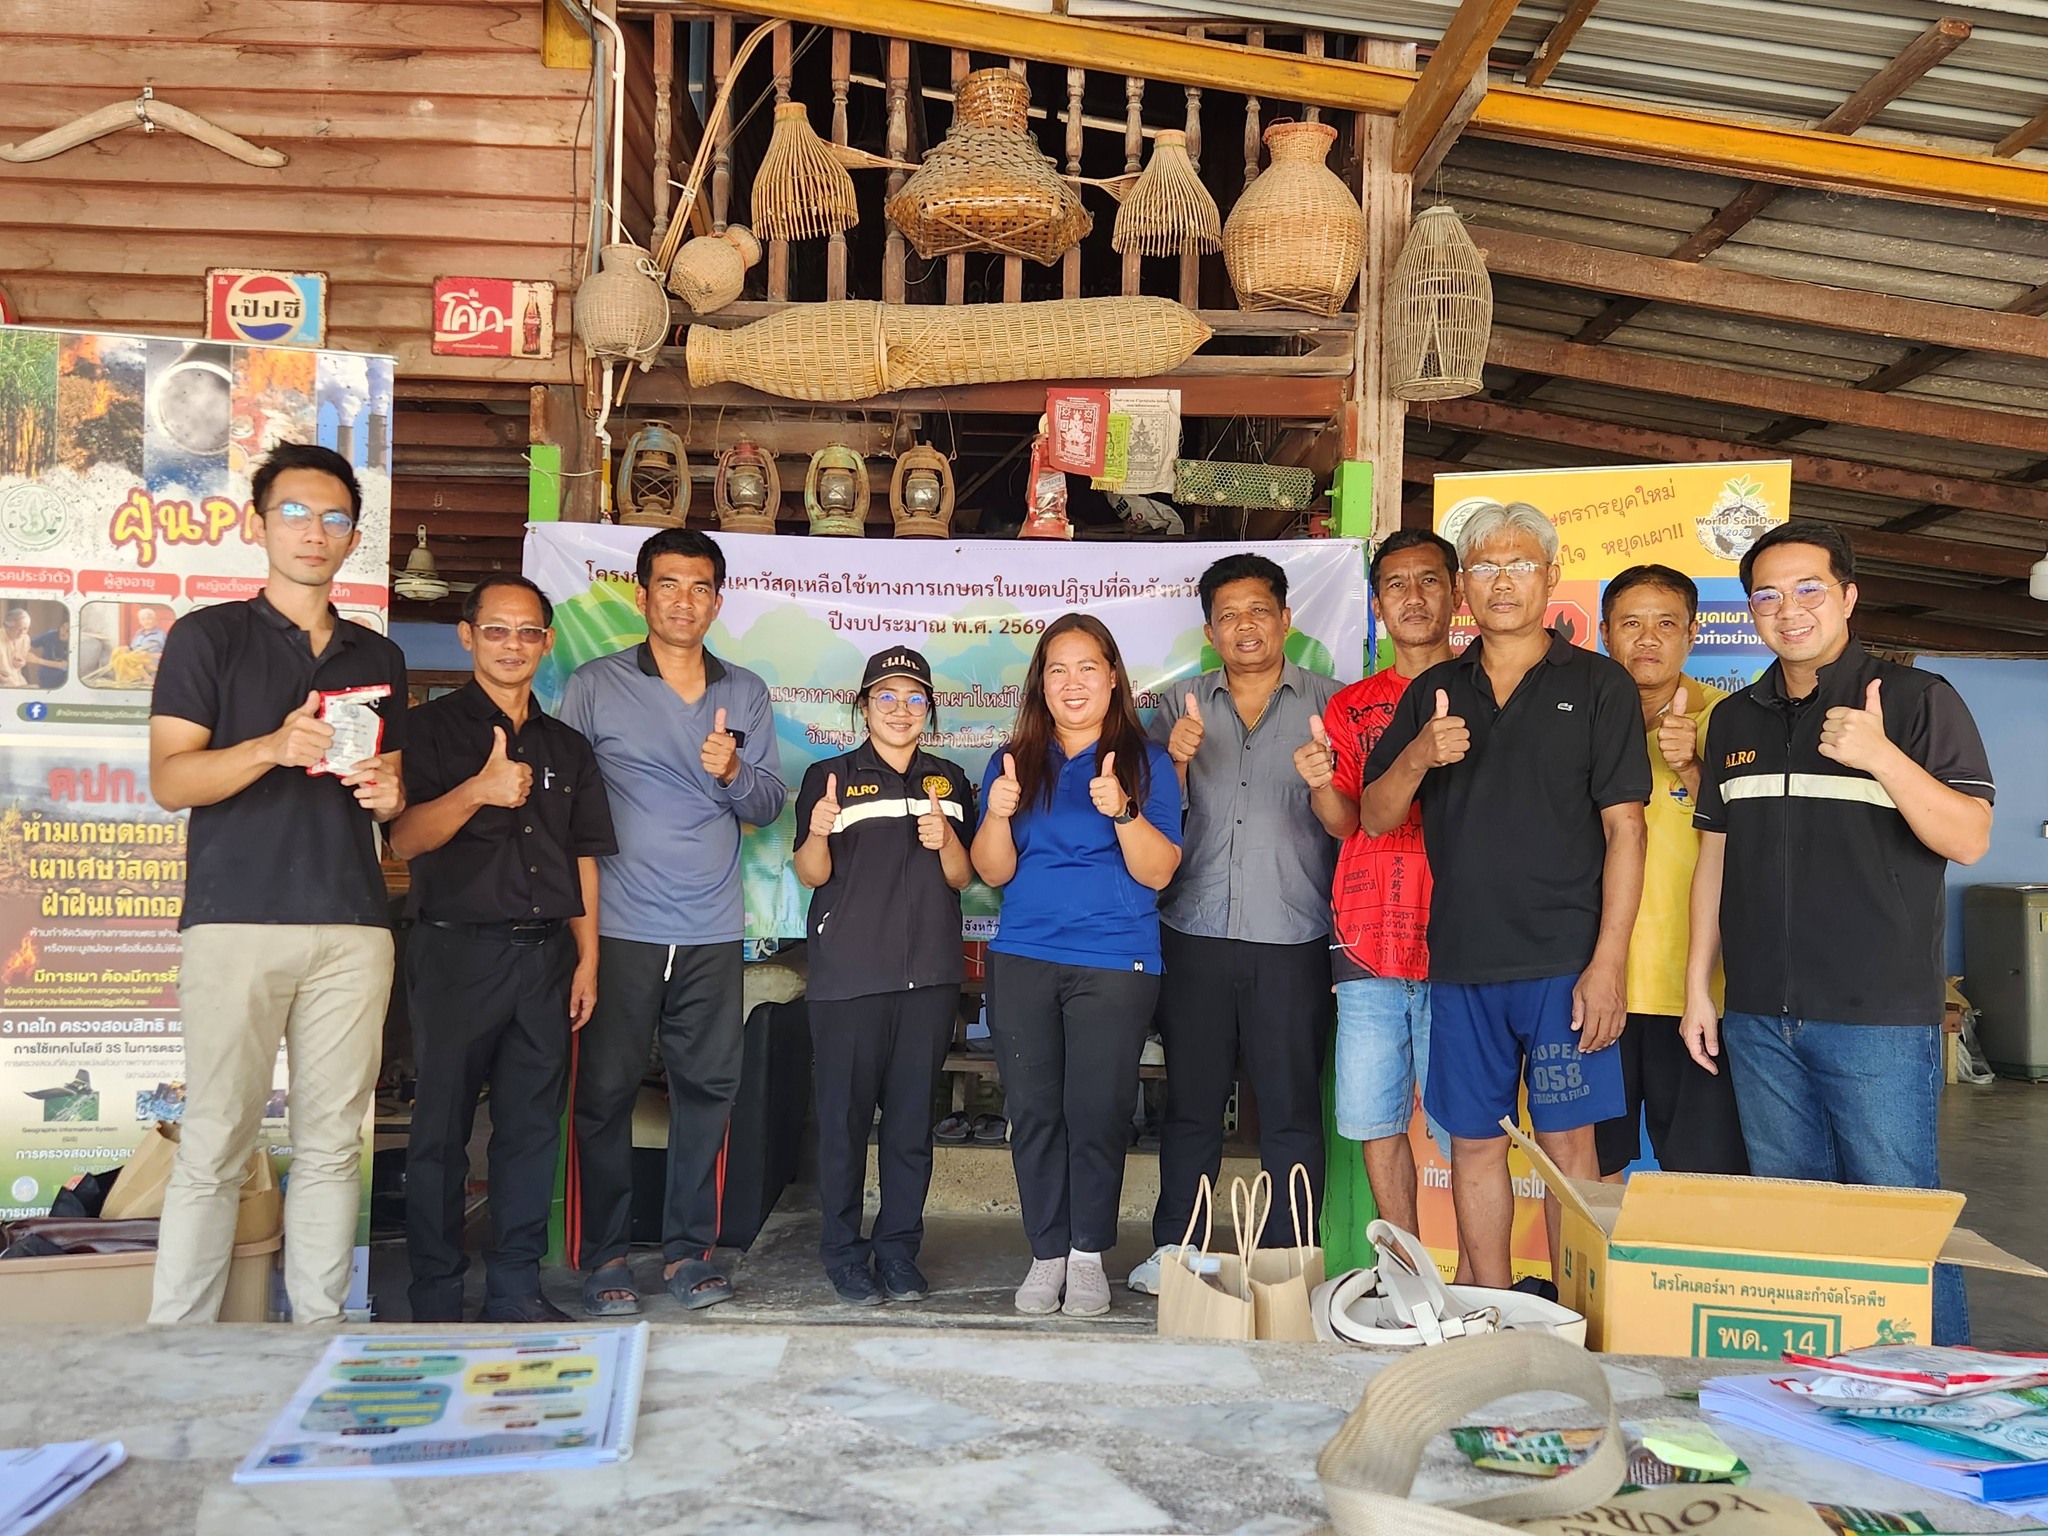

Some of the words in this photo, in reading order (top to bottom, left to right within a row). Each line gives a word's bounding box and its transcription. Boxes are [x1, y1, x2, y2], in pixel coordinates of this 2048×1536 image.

[1695, 516, 1729, 526] World
[1733, 516, 1755, 525] Soil
[1759, 516, 1782, 525] Day
[1601, 523, 1685, 558] หยุดเผา!!
[1726, 529, 1751, 537] 2023
[828, 610, 947, 634] ปีงบประมาณ
[952, 617, 993, 635] พ.ศ.
[999, 618, 1046, 635] 2569
[805, 724, 855, 751] วันพุธ
[917, 724, 994, 749] มภาพันธ์
[1724, 750, 1756, 769] ALRO
[846, 784, 879, 797] ALRO
[34, 968, 98, 983] มีการเผา
[3, 1019, 14, 1033] 3
[17, 1017, 56, 1033] กลไก
[14, 1042, 102, 1054] การใช้เทคโนโลยี
[1533, 1063, 1582, 1092] 058
[1651, 1271, 1735, 1296] ไตรโคเดอร์มา
[1741, 1285, 1887, 1308] ควบคุมและกำจัดโรคพืช
[1717, 1326, 1769, 1352] พด.
[1782, 1329, 1817, 1355] 14
